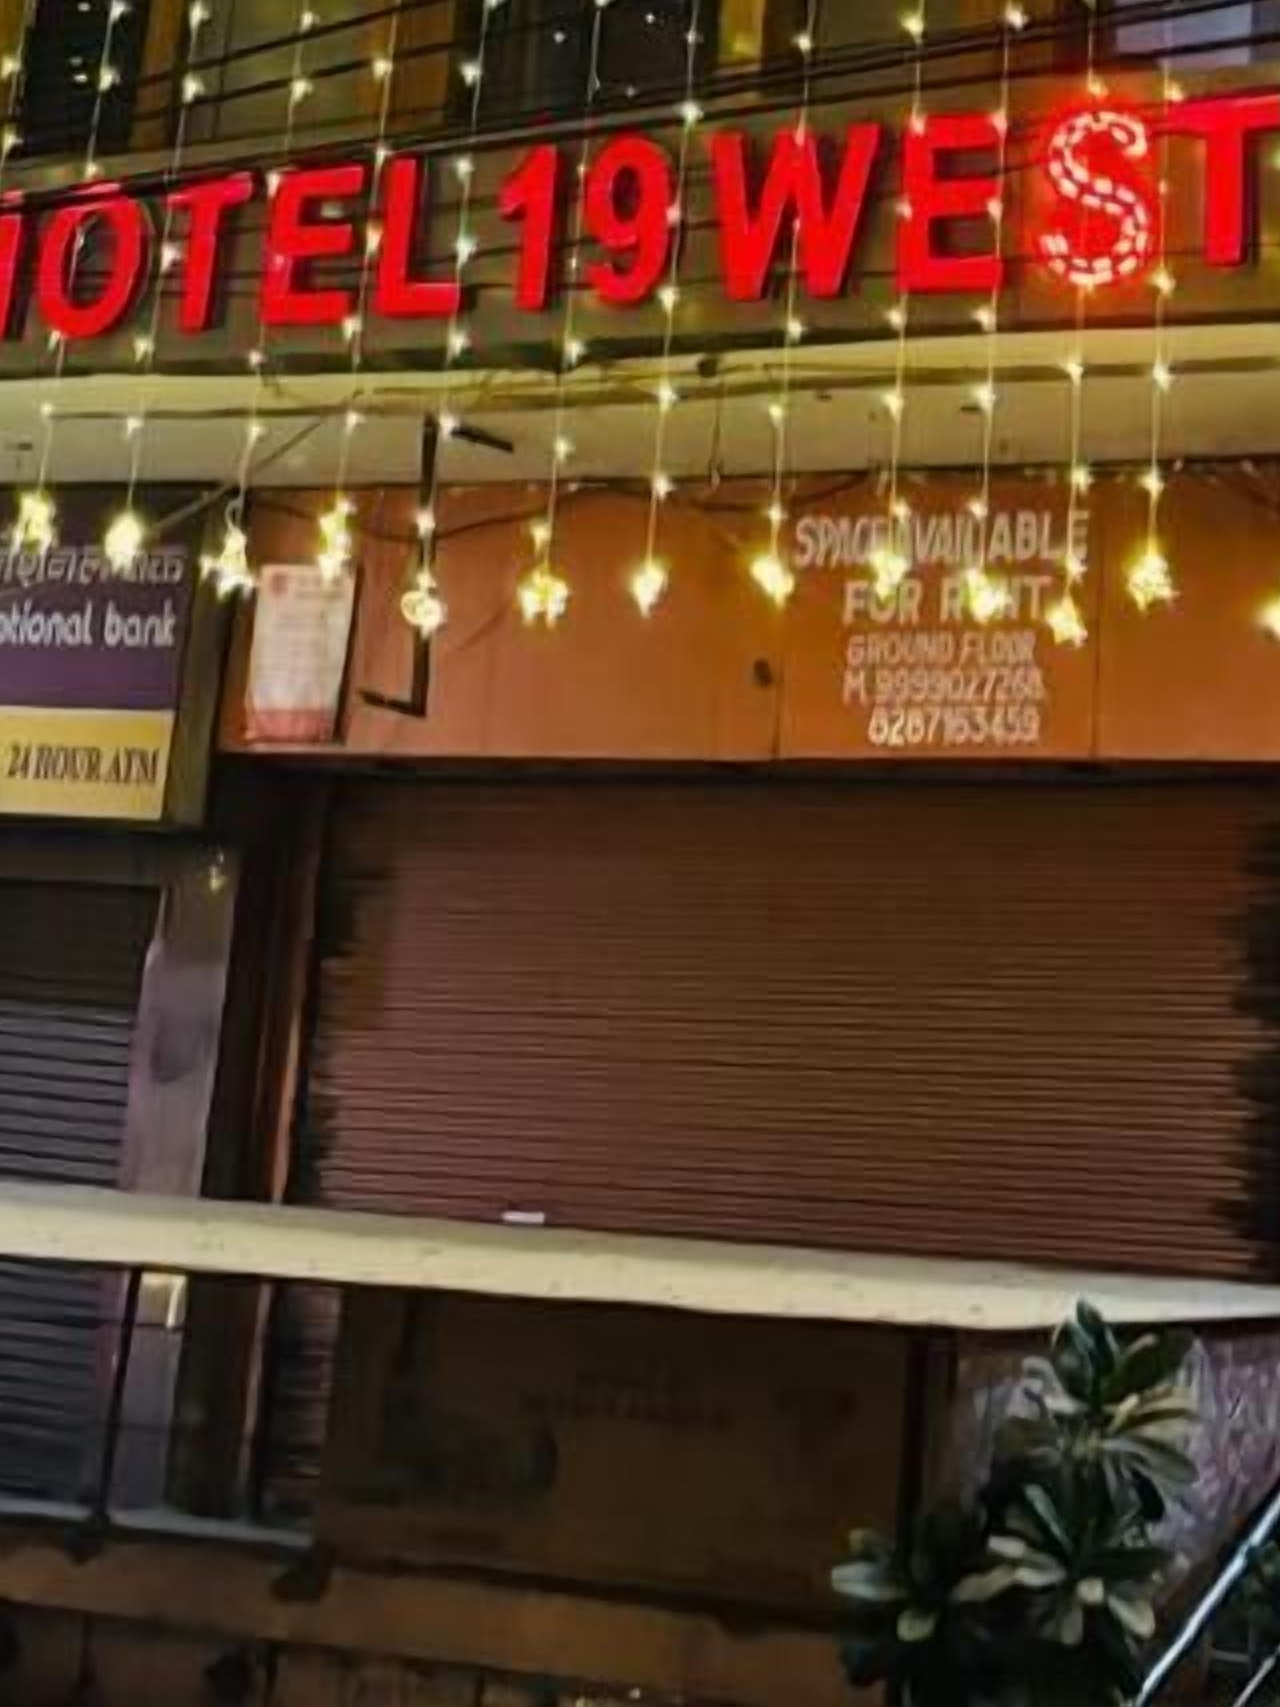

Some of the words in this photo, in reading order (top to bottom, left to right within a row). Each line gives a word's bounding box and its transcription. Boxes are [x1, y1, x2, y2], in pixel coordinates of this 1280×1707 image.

[499, 135, 681, 312] 19
[794, 513, 888, 568] SPACE
[103, 597, 177, 648] bank
[842, 578, 924, 626] FOR
[940, 575, 1053, 624] RNT
[847, 632, 956, 667] GROUND
[958, 630, 1038, 668] FLOOR
[7, 743, 32, 780] 24
[32, 746, 101, 782] HOUR
[103, 747, 160, 785] ATM
